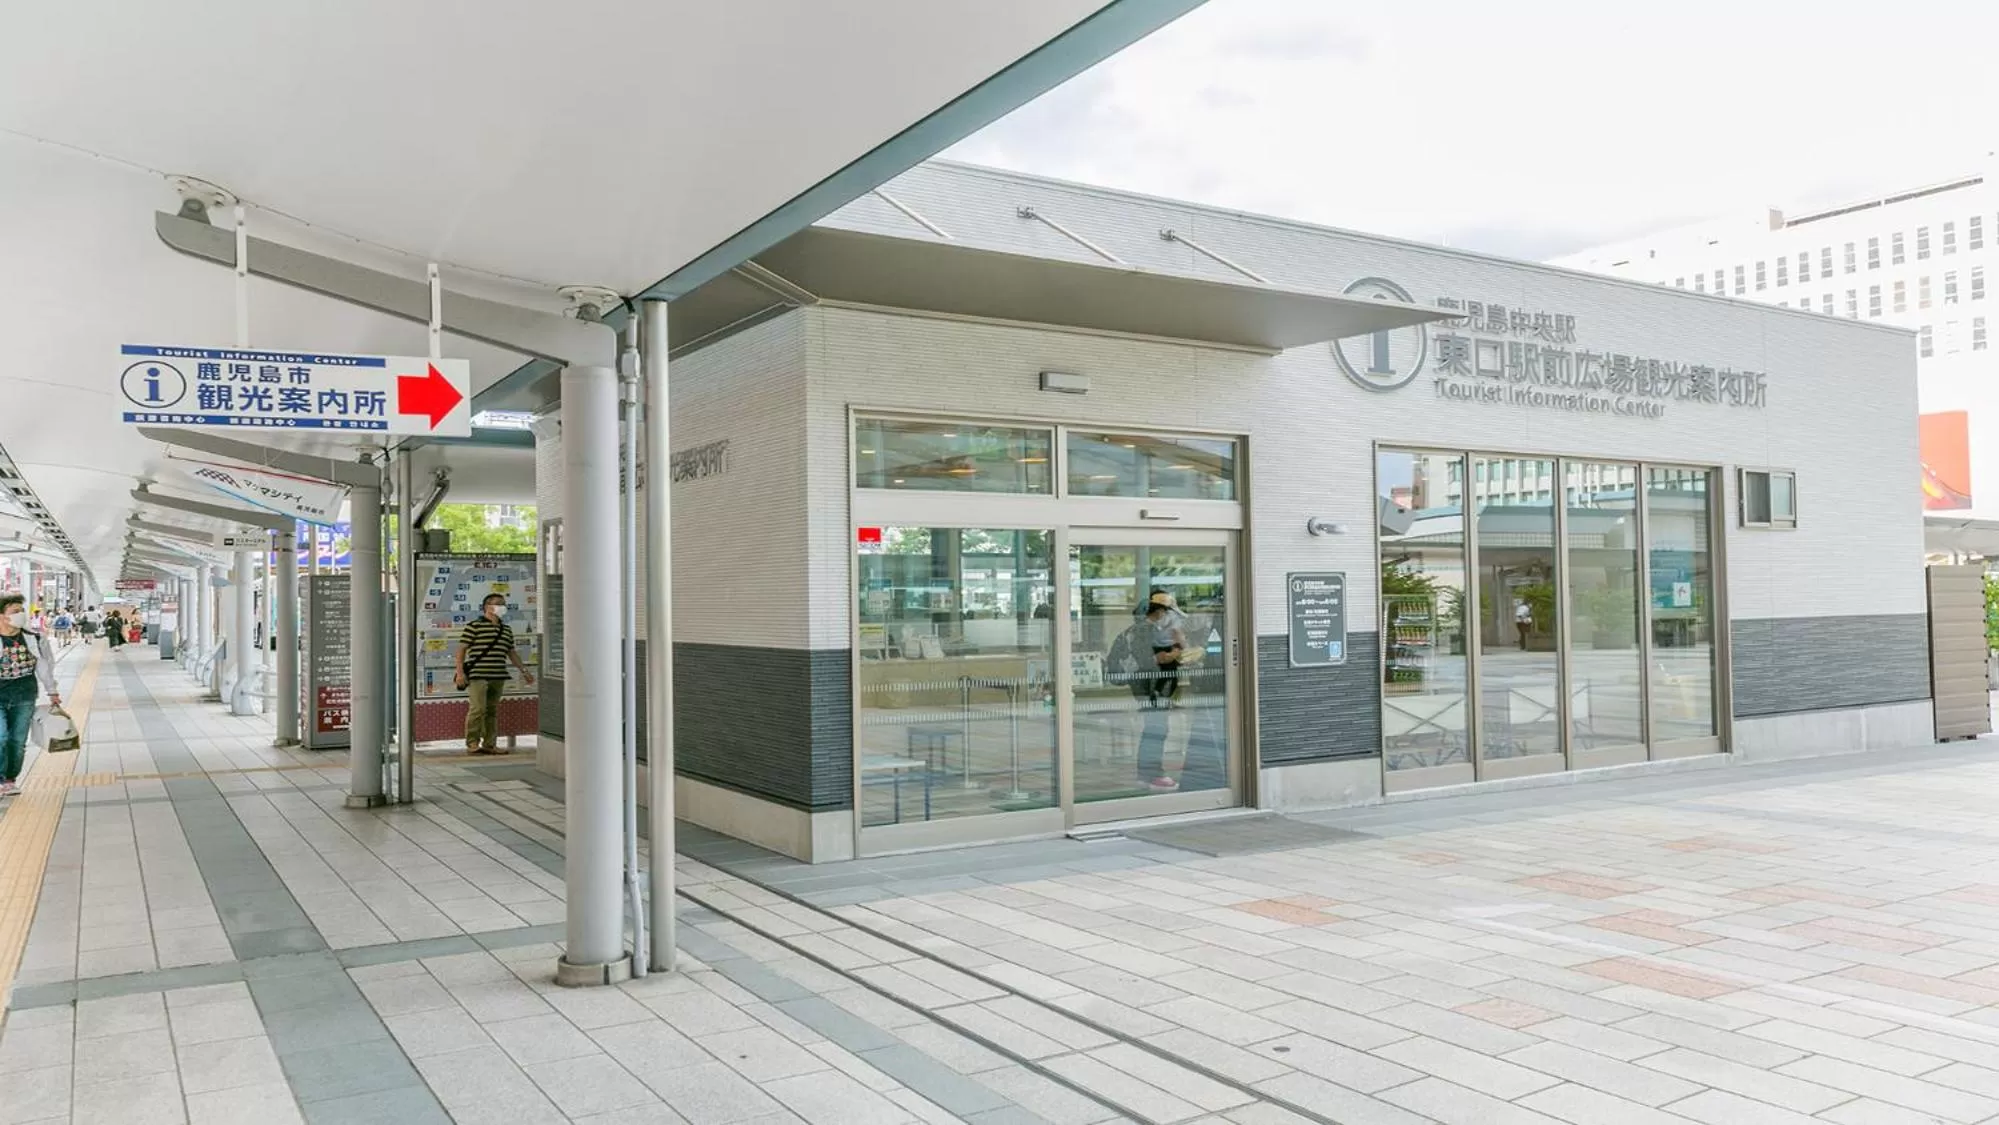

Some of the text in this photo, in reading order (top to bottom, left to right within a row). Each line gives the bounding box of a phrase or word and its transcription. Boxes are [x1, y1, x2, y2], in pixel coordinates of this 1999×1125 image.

[1433, 297, 1577, 344] 鹿児島中央駅
[157, 348, 358, 365] Tourist Information Center
[197, 362, 311, 384] 鹿児島市
[1432, 331, 1768, 408] 東口駅前広場観光案内所
[197, 383, 386, 416] 観光案内所
[1433, 378, 1667, 418] Tourist Information Center
